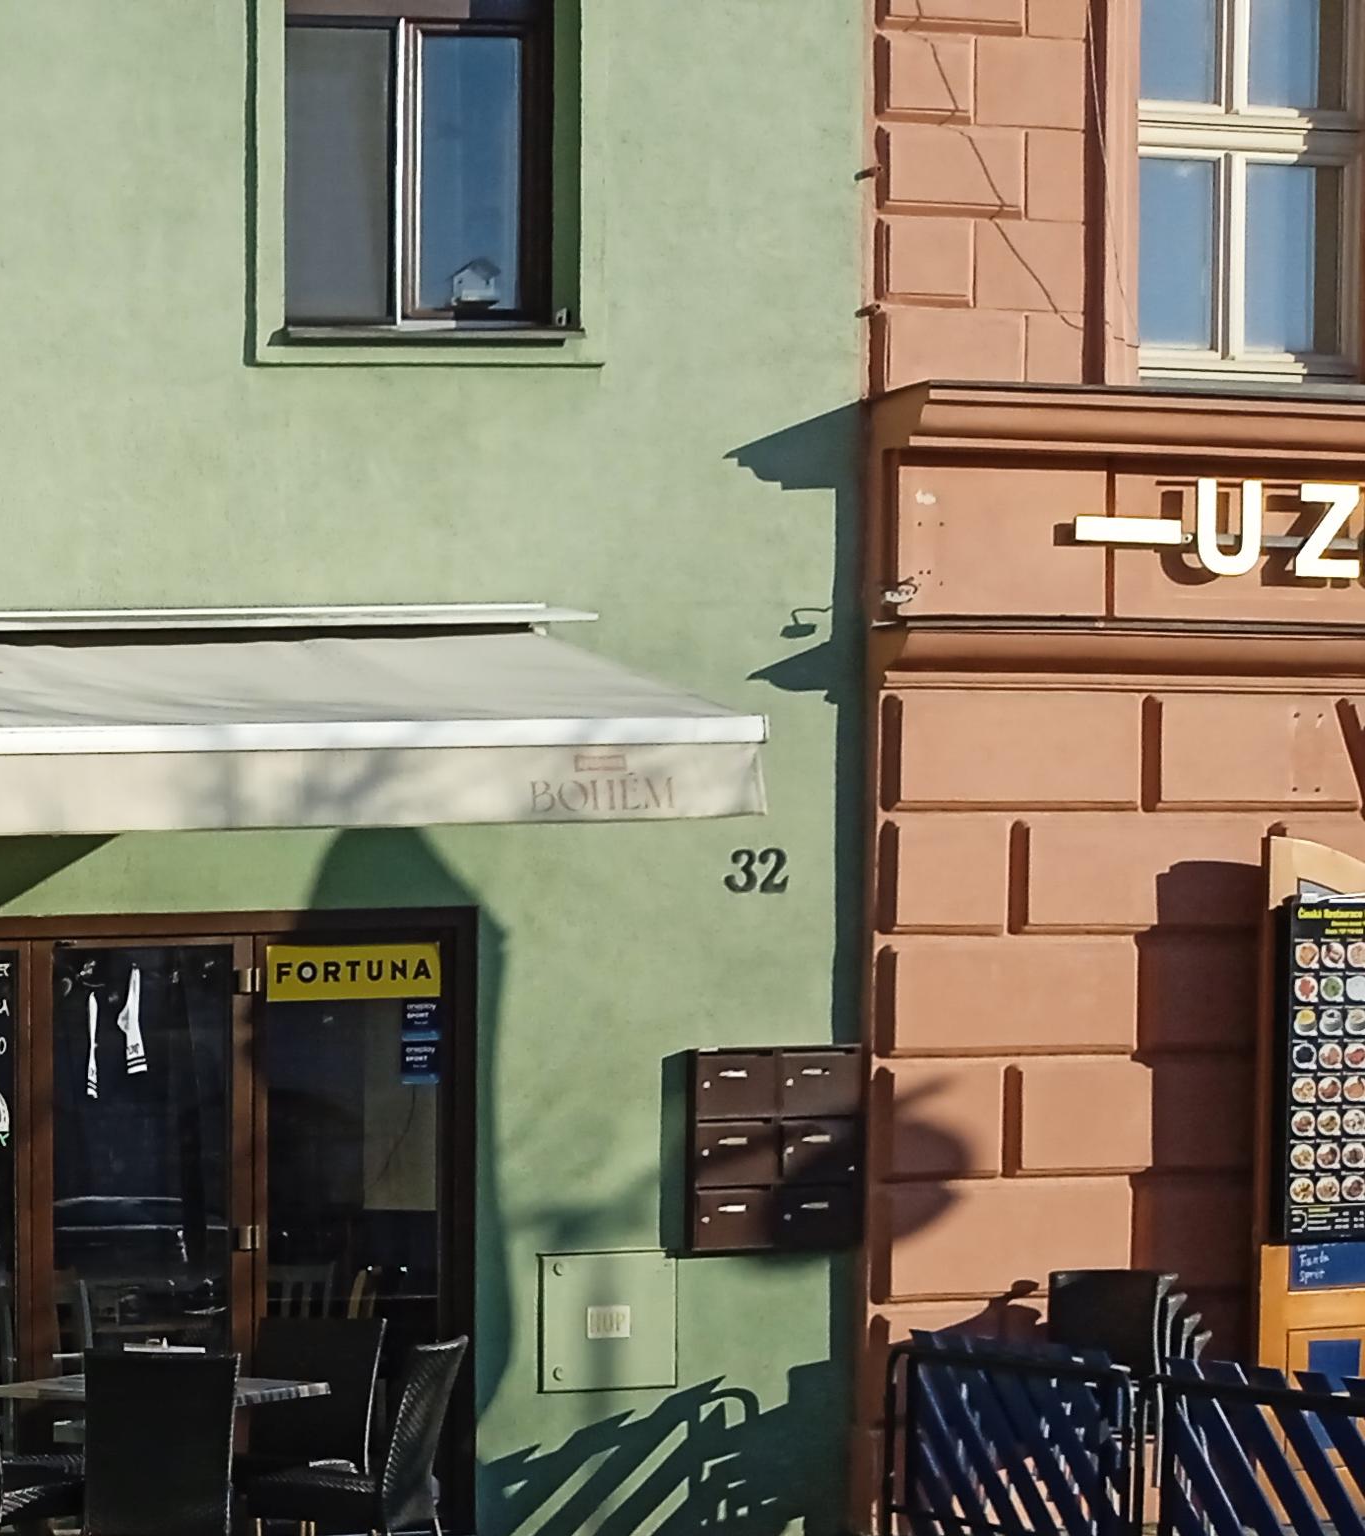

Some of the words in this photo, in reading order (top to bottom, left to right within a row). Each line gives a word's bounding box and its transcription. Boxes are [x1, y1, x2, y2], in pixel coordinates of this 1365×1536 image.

[1197, 477, 1263, 577] U
[530, 772, 677, 813] BOHÉM
[723, 847, 789, 894] 32
[276, 958, 432, 984] FORTUNA
